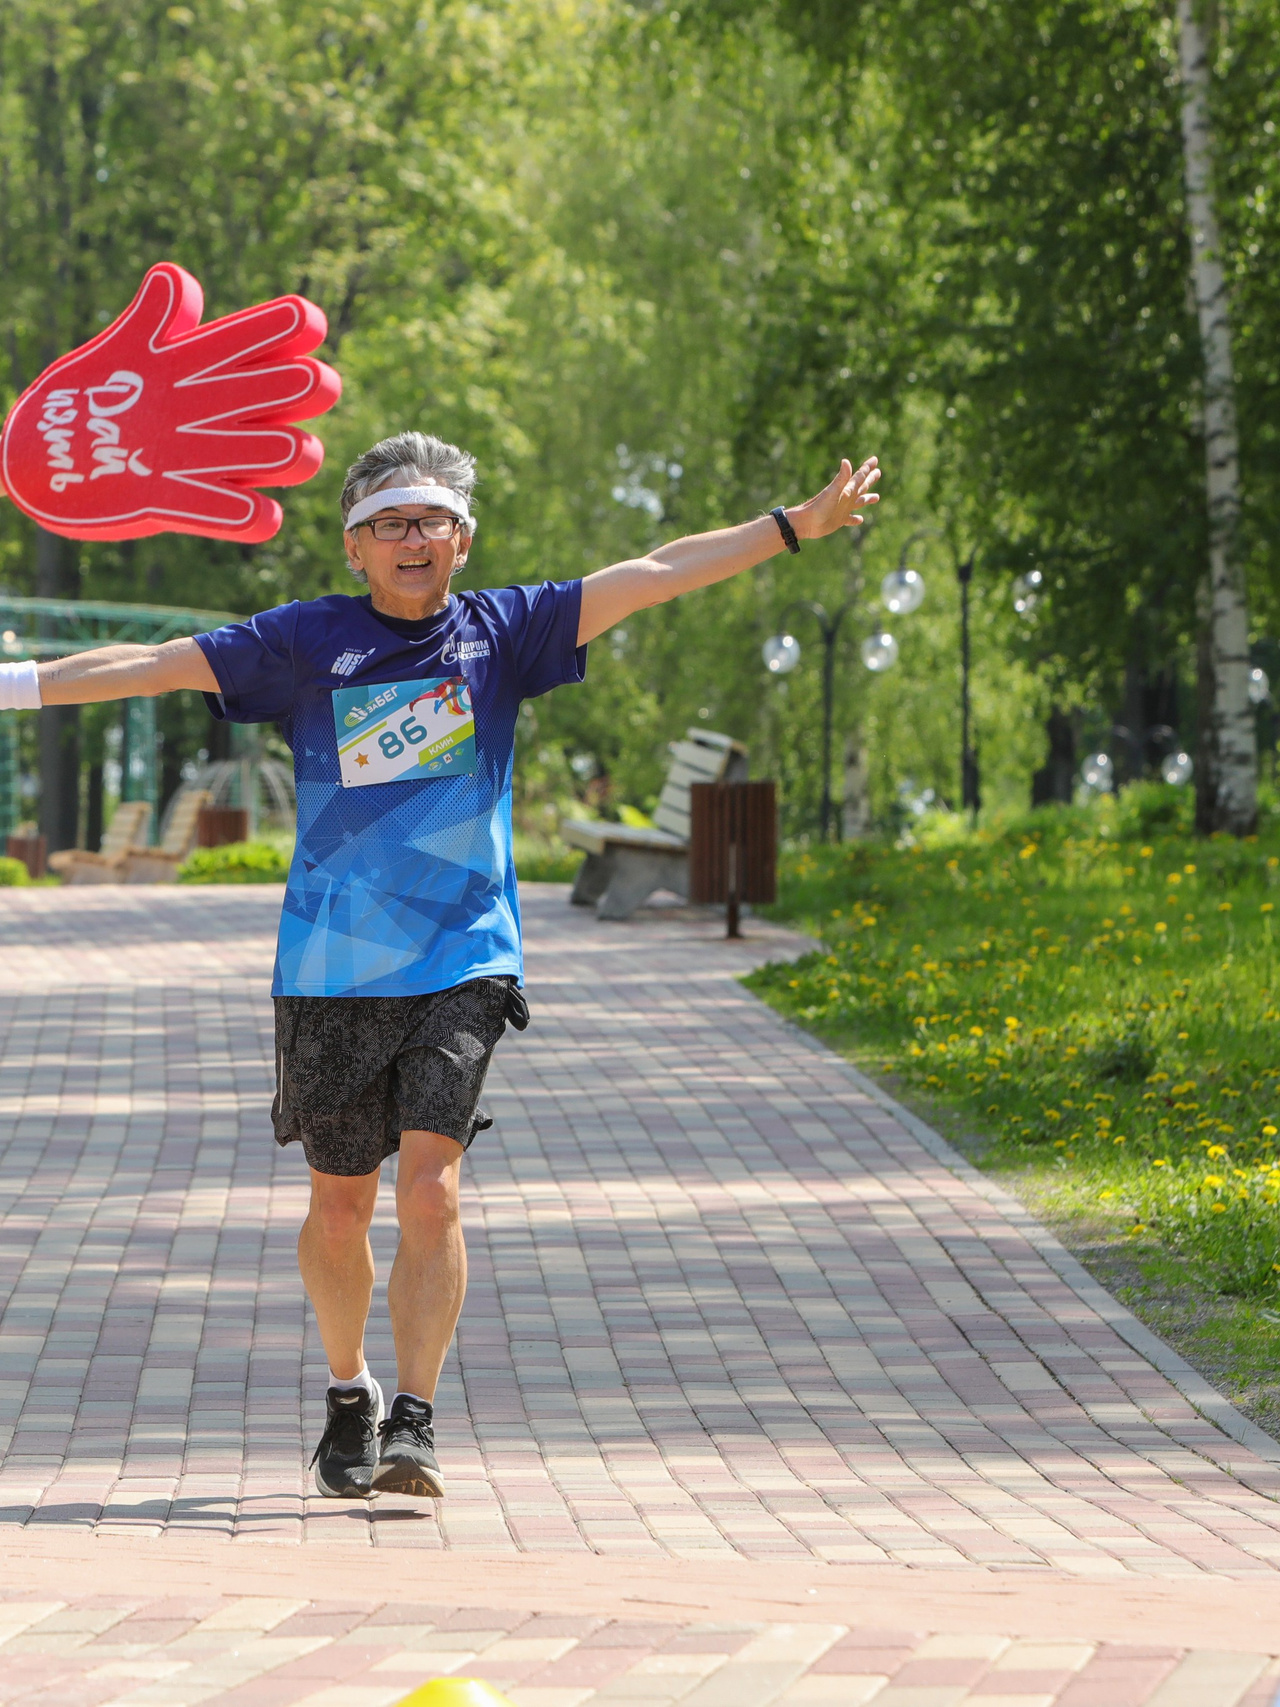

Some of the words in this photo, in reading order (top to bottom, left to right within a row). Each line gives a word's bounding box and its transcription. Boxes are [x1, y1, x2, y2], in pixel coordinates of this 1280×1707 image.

[36, 388, 85, 492] пять
[83, 370, 153, 481] Дай
[330, 660, 357, 676] RUN
[336, 651, 368, 666] JUST
[377, 715, 428, 760] 86
[428, 735, 454, 756] КЛИН
